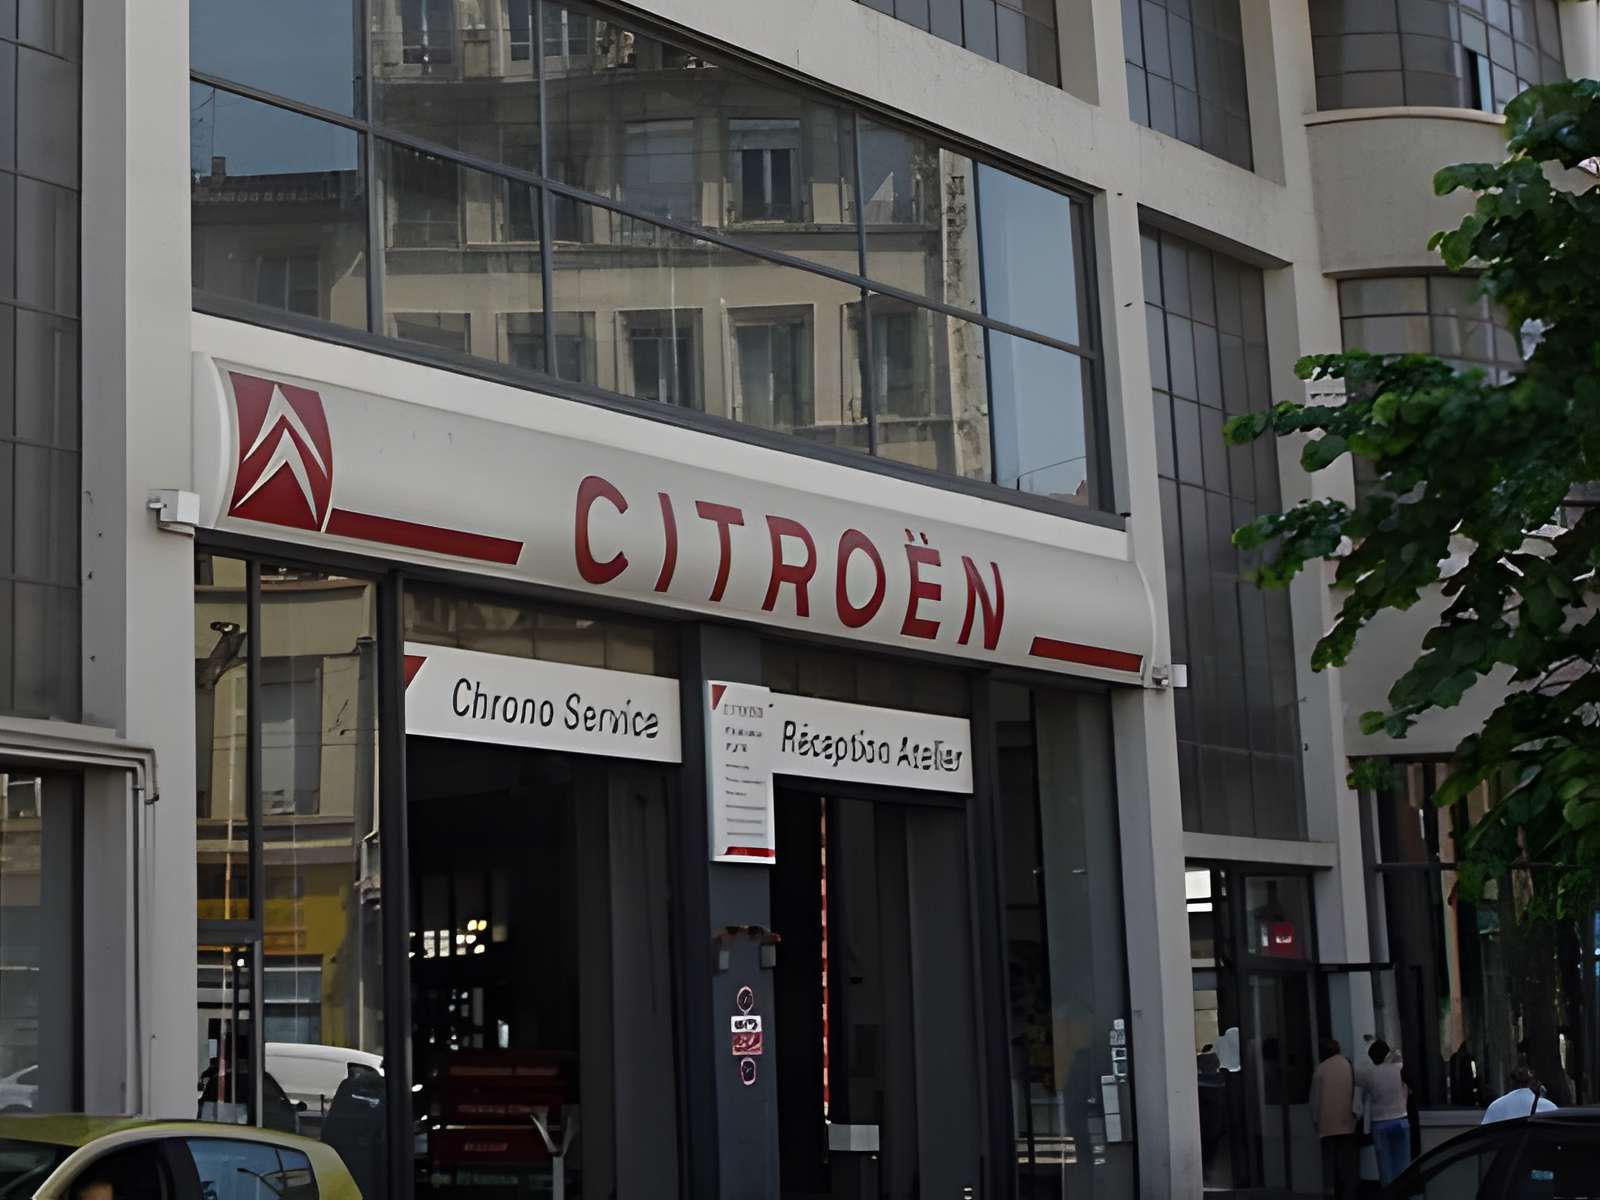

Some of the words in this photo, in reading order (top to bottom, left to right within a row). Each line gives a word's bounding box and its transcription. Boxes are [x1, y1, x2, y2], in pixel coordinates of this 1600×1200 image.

[574, 475, 1006, 651] CITROËN
[452, 677, 554, 727] Chrono
[564, 692, 659, 739] Service
